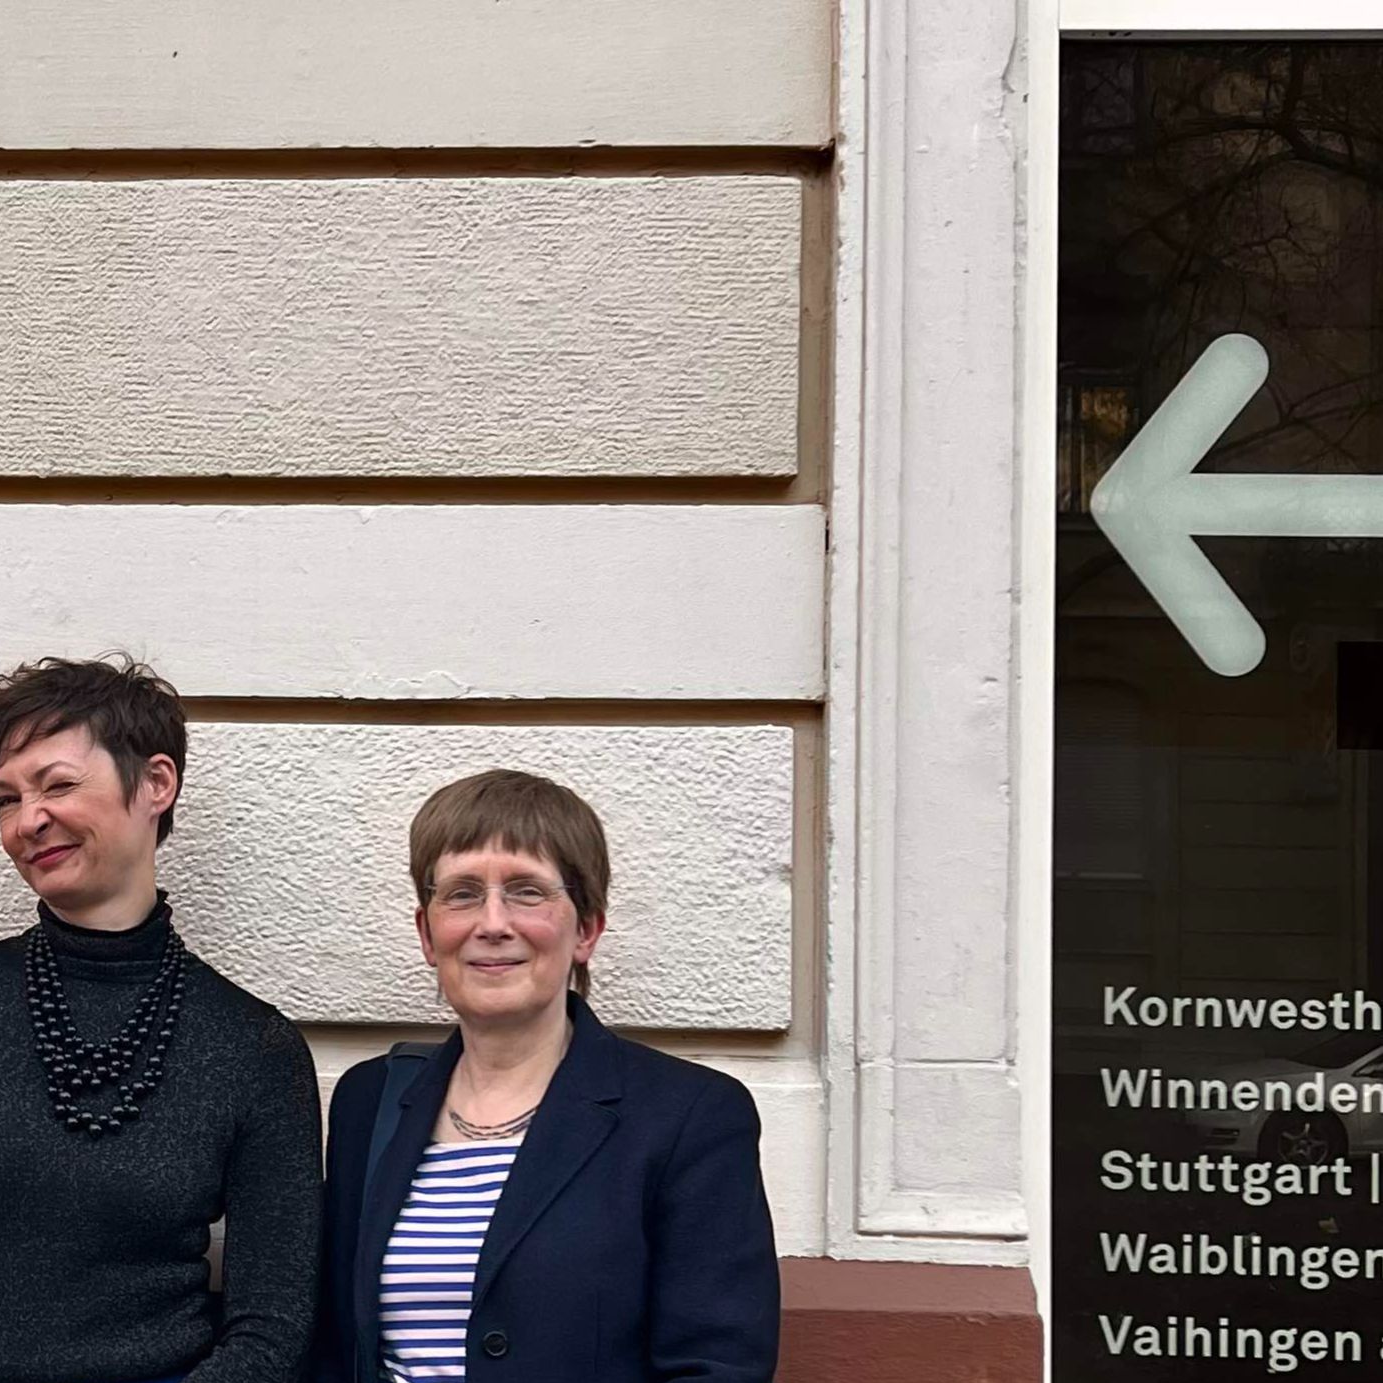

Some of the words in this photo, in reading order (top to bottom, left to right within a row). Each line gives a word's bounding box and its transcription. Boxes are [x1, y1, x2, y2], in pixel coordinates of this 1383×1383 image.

[1100, 1068, 1383, 1114] Winnenden
[1100, 1150, 1352, 1206] Stuttgart
[1098, 1315, 1361, 1372] Vaihingen
